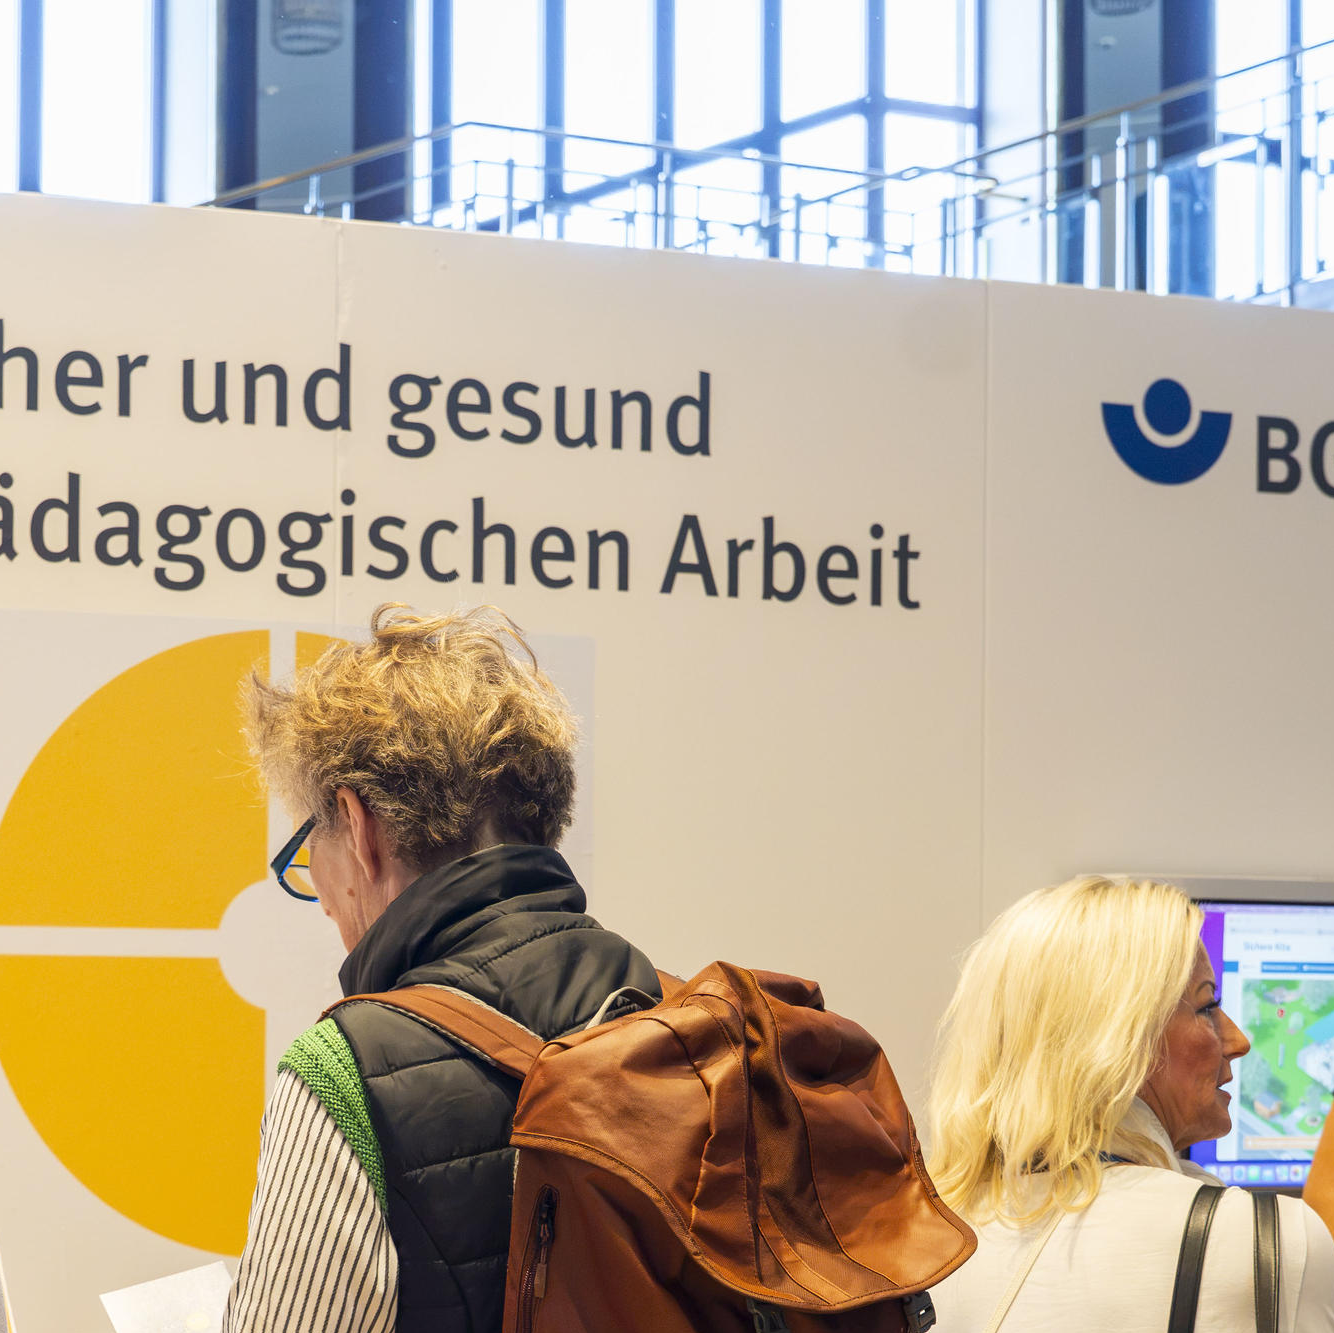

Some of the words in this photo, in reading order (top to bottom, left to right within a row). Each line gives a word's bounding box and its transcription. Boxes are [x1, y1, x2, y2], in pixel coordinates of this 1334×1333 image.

[181, 342, 353, 433] und
[386, 370, 712, 460] gesund
[659, 513, 921, 611] Arbeit
